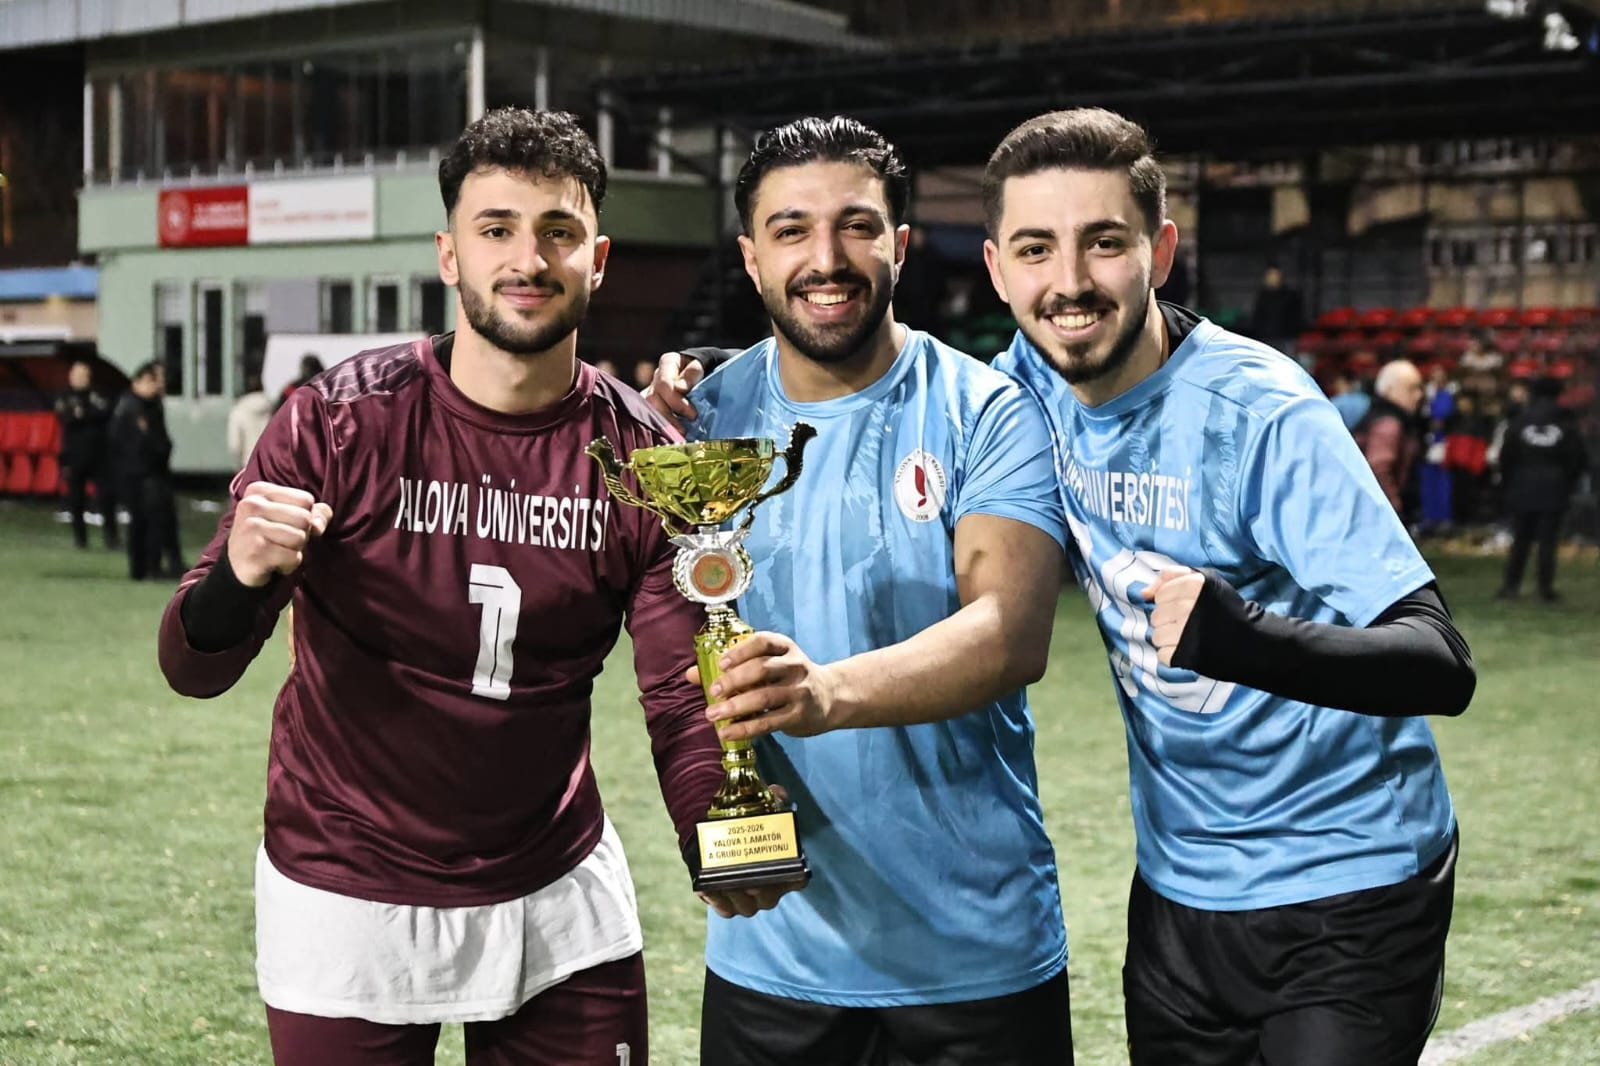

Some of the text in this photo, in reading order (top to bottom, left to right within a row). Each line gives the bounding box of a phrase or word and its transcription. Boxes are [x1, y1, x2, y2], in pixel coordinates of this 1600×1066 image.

[468, 563, 522, 701] 1
[728, 823, 765, 835] 2025-2026
[713, 837, 742, 848] YALOVA
[743, 843, 789, 859] ŞAMPİYONU
